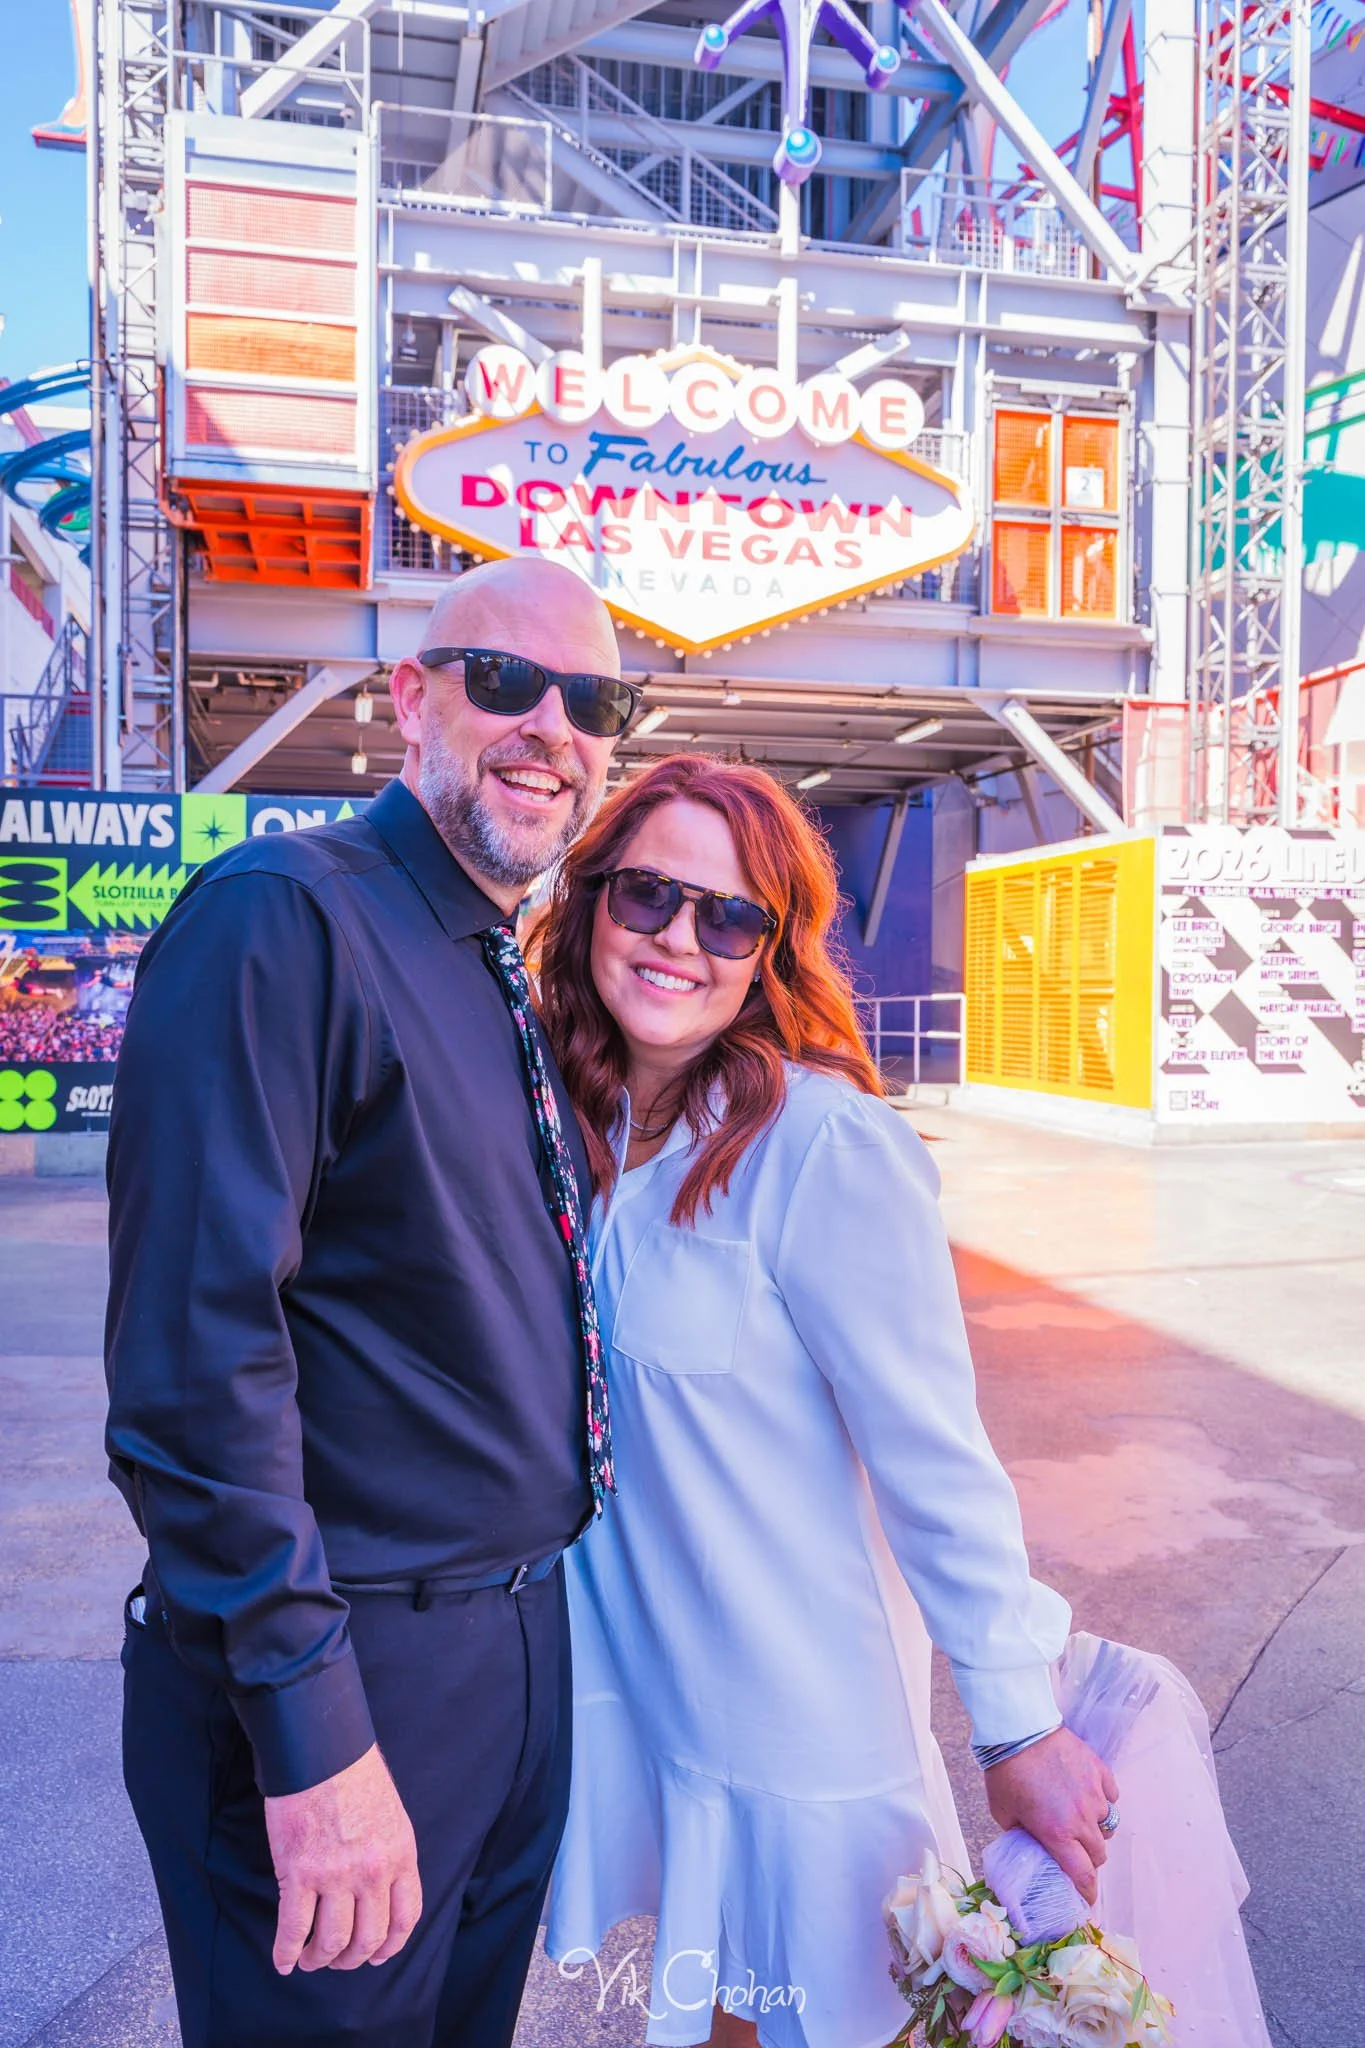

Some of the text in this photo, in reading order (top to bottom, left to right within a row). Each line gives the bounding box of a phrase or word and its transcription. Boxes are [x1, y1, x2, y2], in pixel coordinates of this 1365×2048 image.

[478, 358, 907, 436] WELCOME
[525, 430, 827, 486] TO Fabulous
[461, 474, 912, 538] DOWNTOWN
[519, 517, 863, 569] LAS VEGAS
[600, 567, 785, 599] NEVADA
[0, 799, 174, 848] ALWAYS
[1167, 843, 1271, 881] 2026
[93, 885, 164, 899] SLOTZILLA
[1261, 923, 1304, 933] GEORGE
[1261, 956, 1305, 966] SLEEPING
[1261, 970, 1284, 980] WITH
[1304, 1003, 1341, 1013] PARADE
[1260, 1036, 1308, 1046] STORY OF
[1260, 1050, 1302, 1060] THE YEAR
